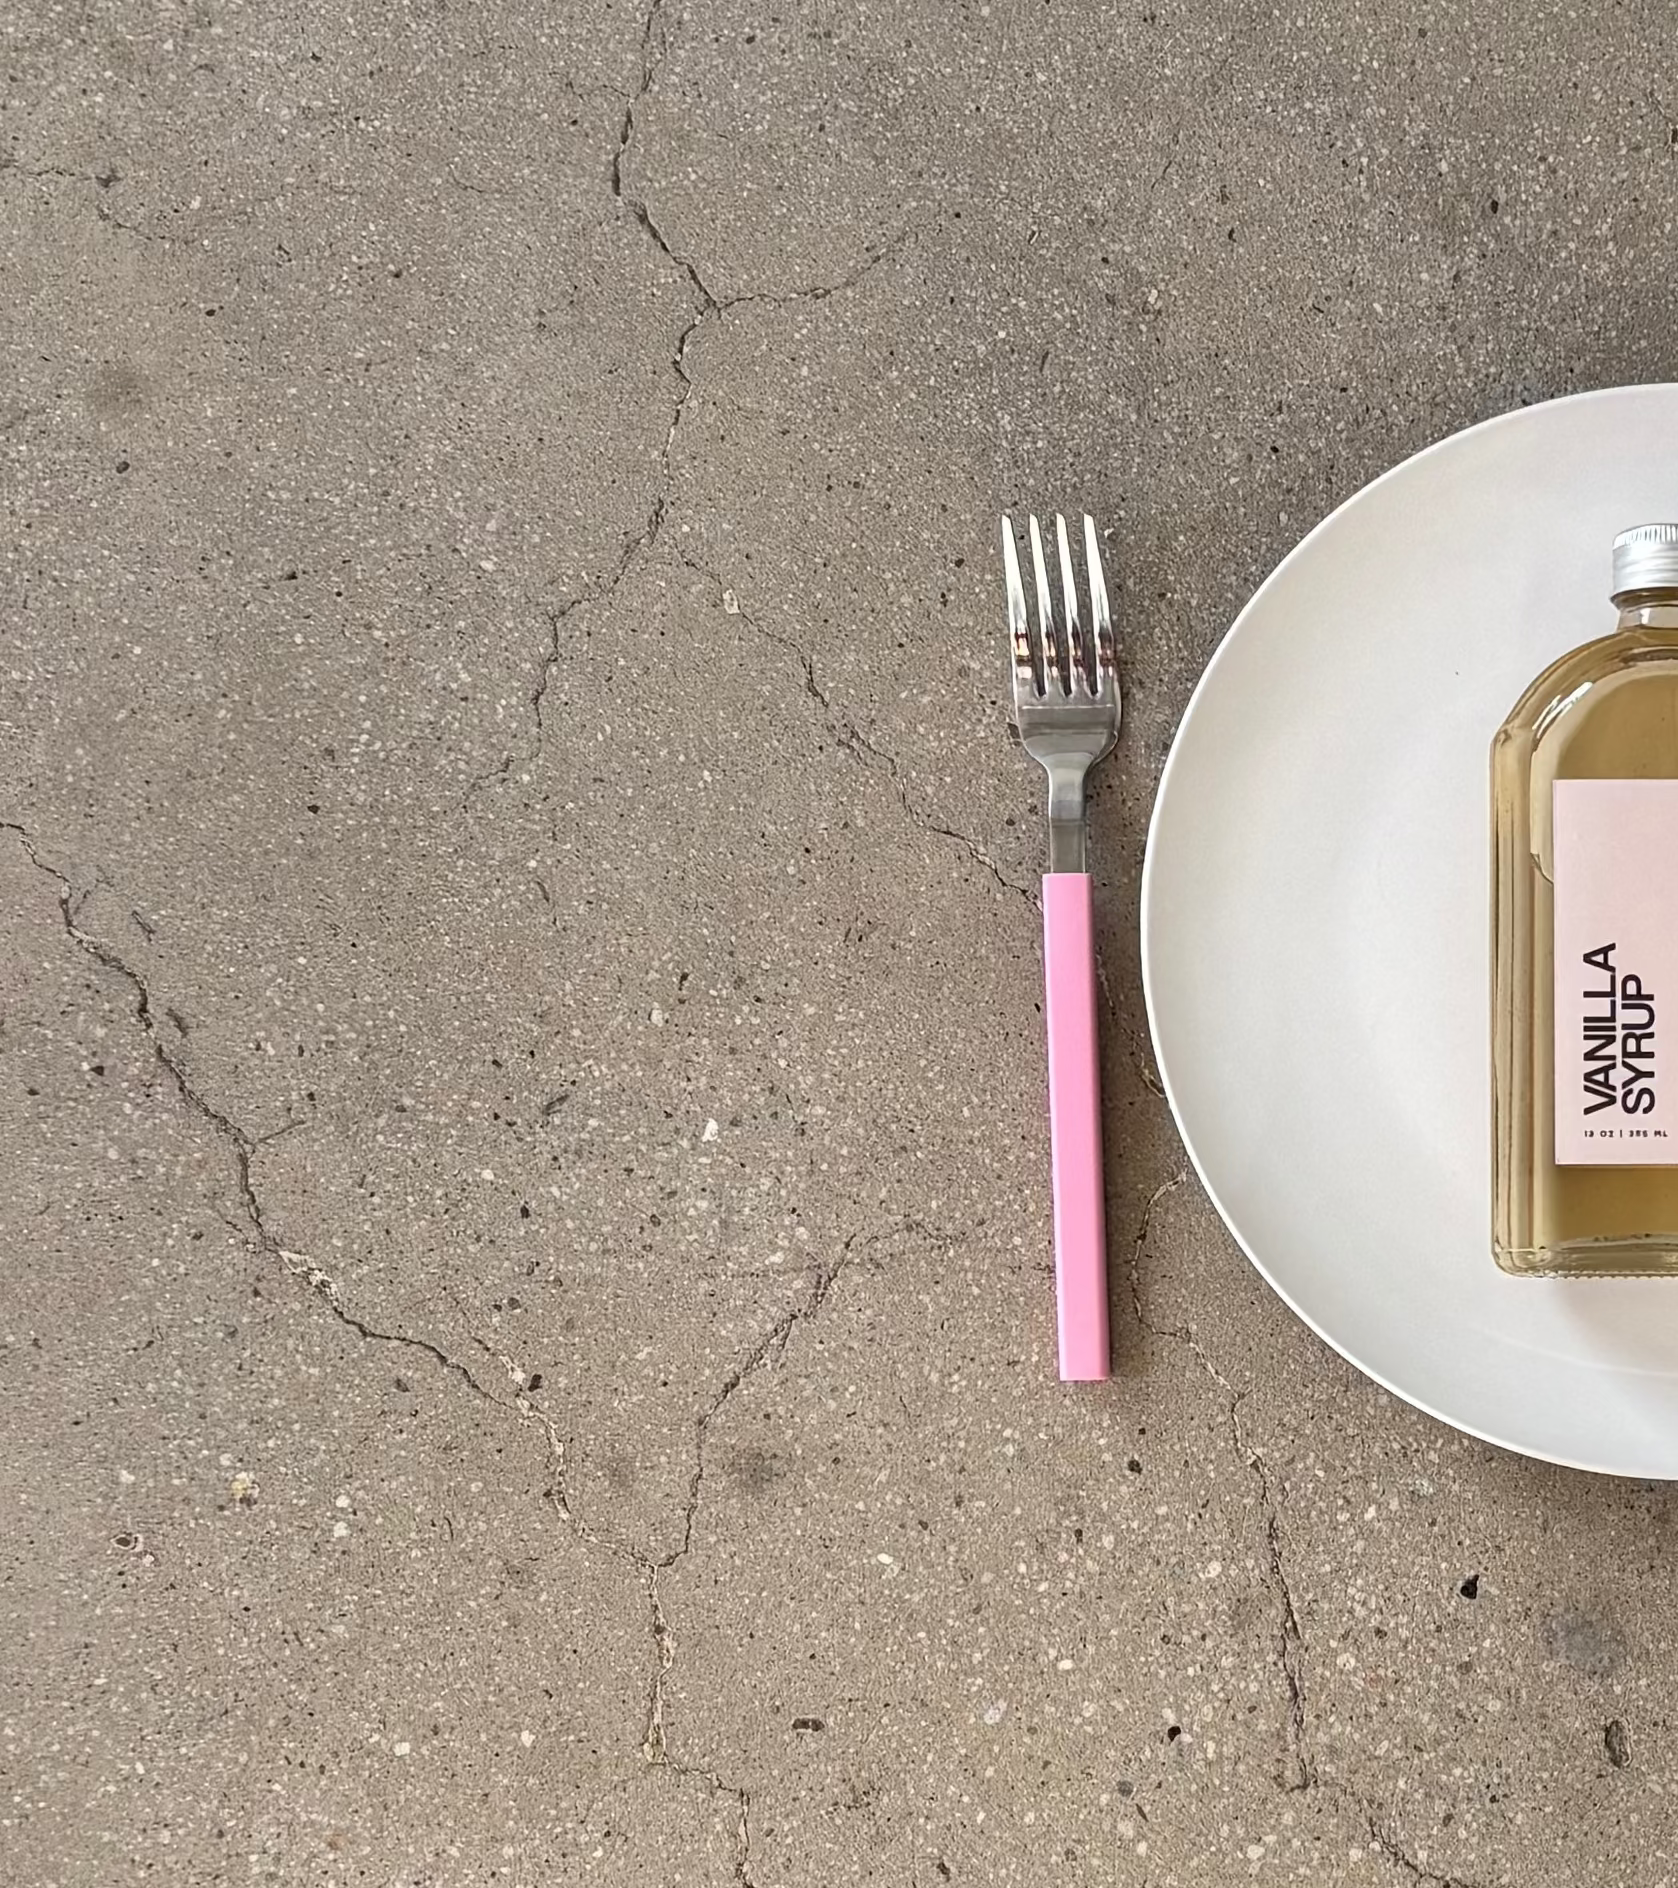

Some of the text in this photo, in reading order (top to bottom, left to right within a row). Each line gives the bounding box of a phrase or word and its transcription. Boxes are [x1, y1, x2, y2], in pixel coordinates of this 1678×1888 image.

[1582, 942, 1617, 1116] VANILLA
[1620, 973, 1656, 1115] SYRUP
[1599, 1129, 1615, 1138] OZ
[1653, 1129, 1669, 1138] ML
